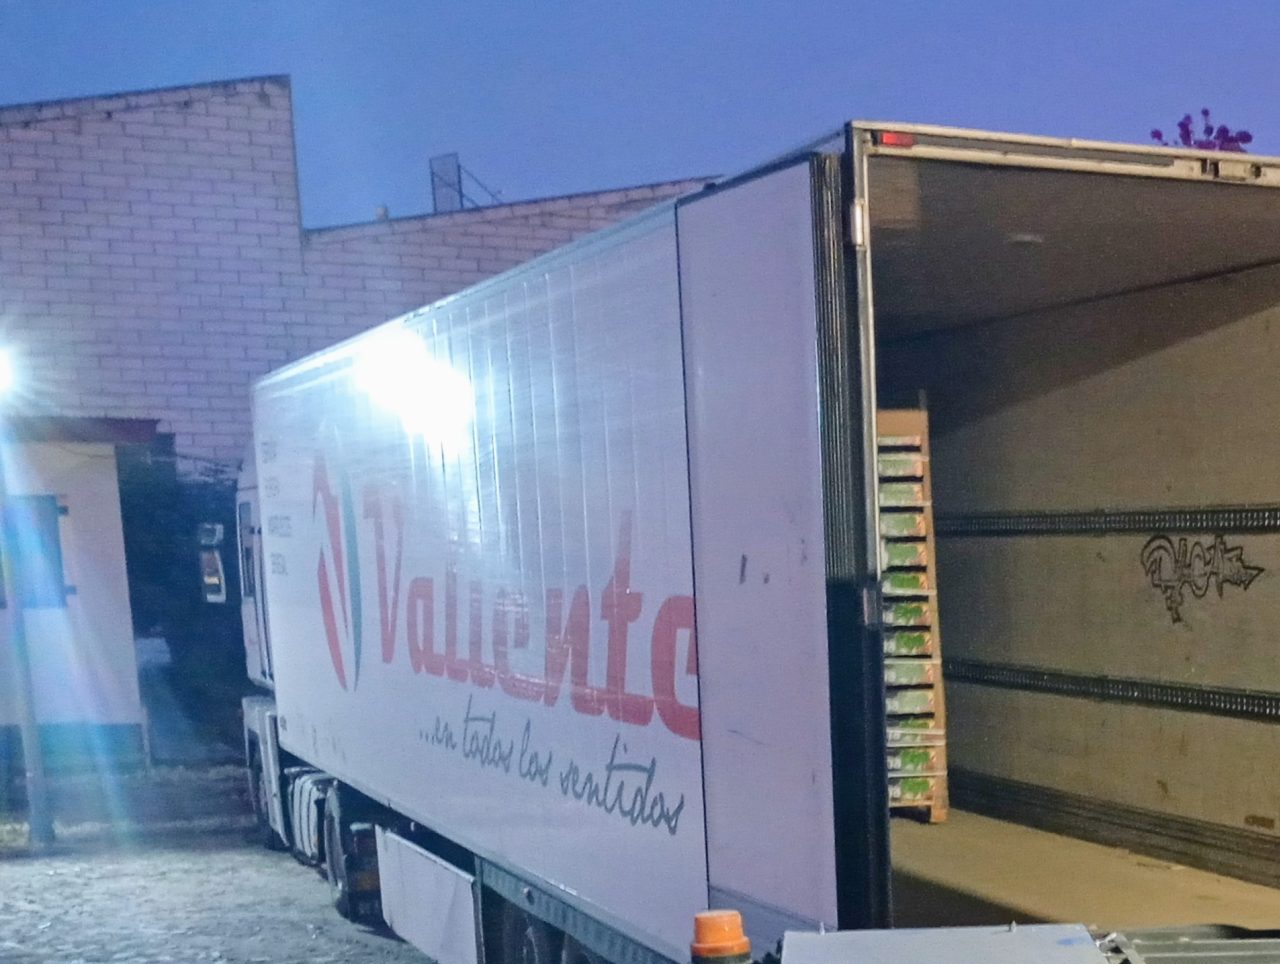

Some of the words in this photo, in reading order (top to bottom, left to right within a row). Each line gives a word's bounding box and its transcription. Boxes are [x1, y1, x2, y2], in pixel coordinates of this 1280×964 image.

[363, 484, 701, 740] Valiente
[463, 693, 513, 773] todos
[519, 716, 552, 786] los
[560, 733, 684, 835] sentidos
